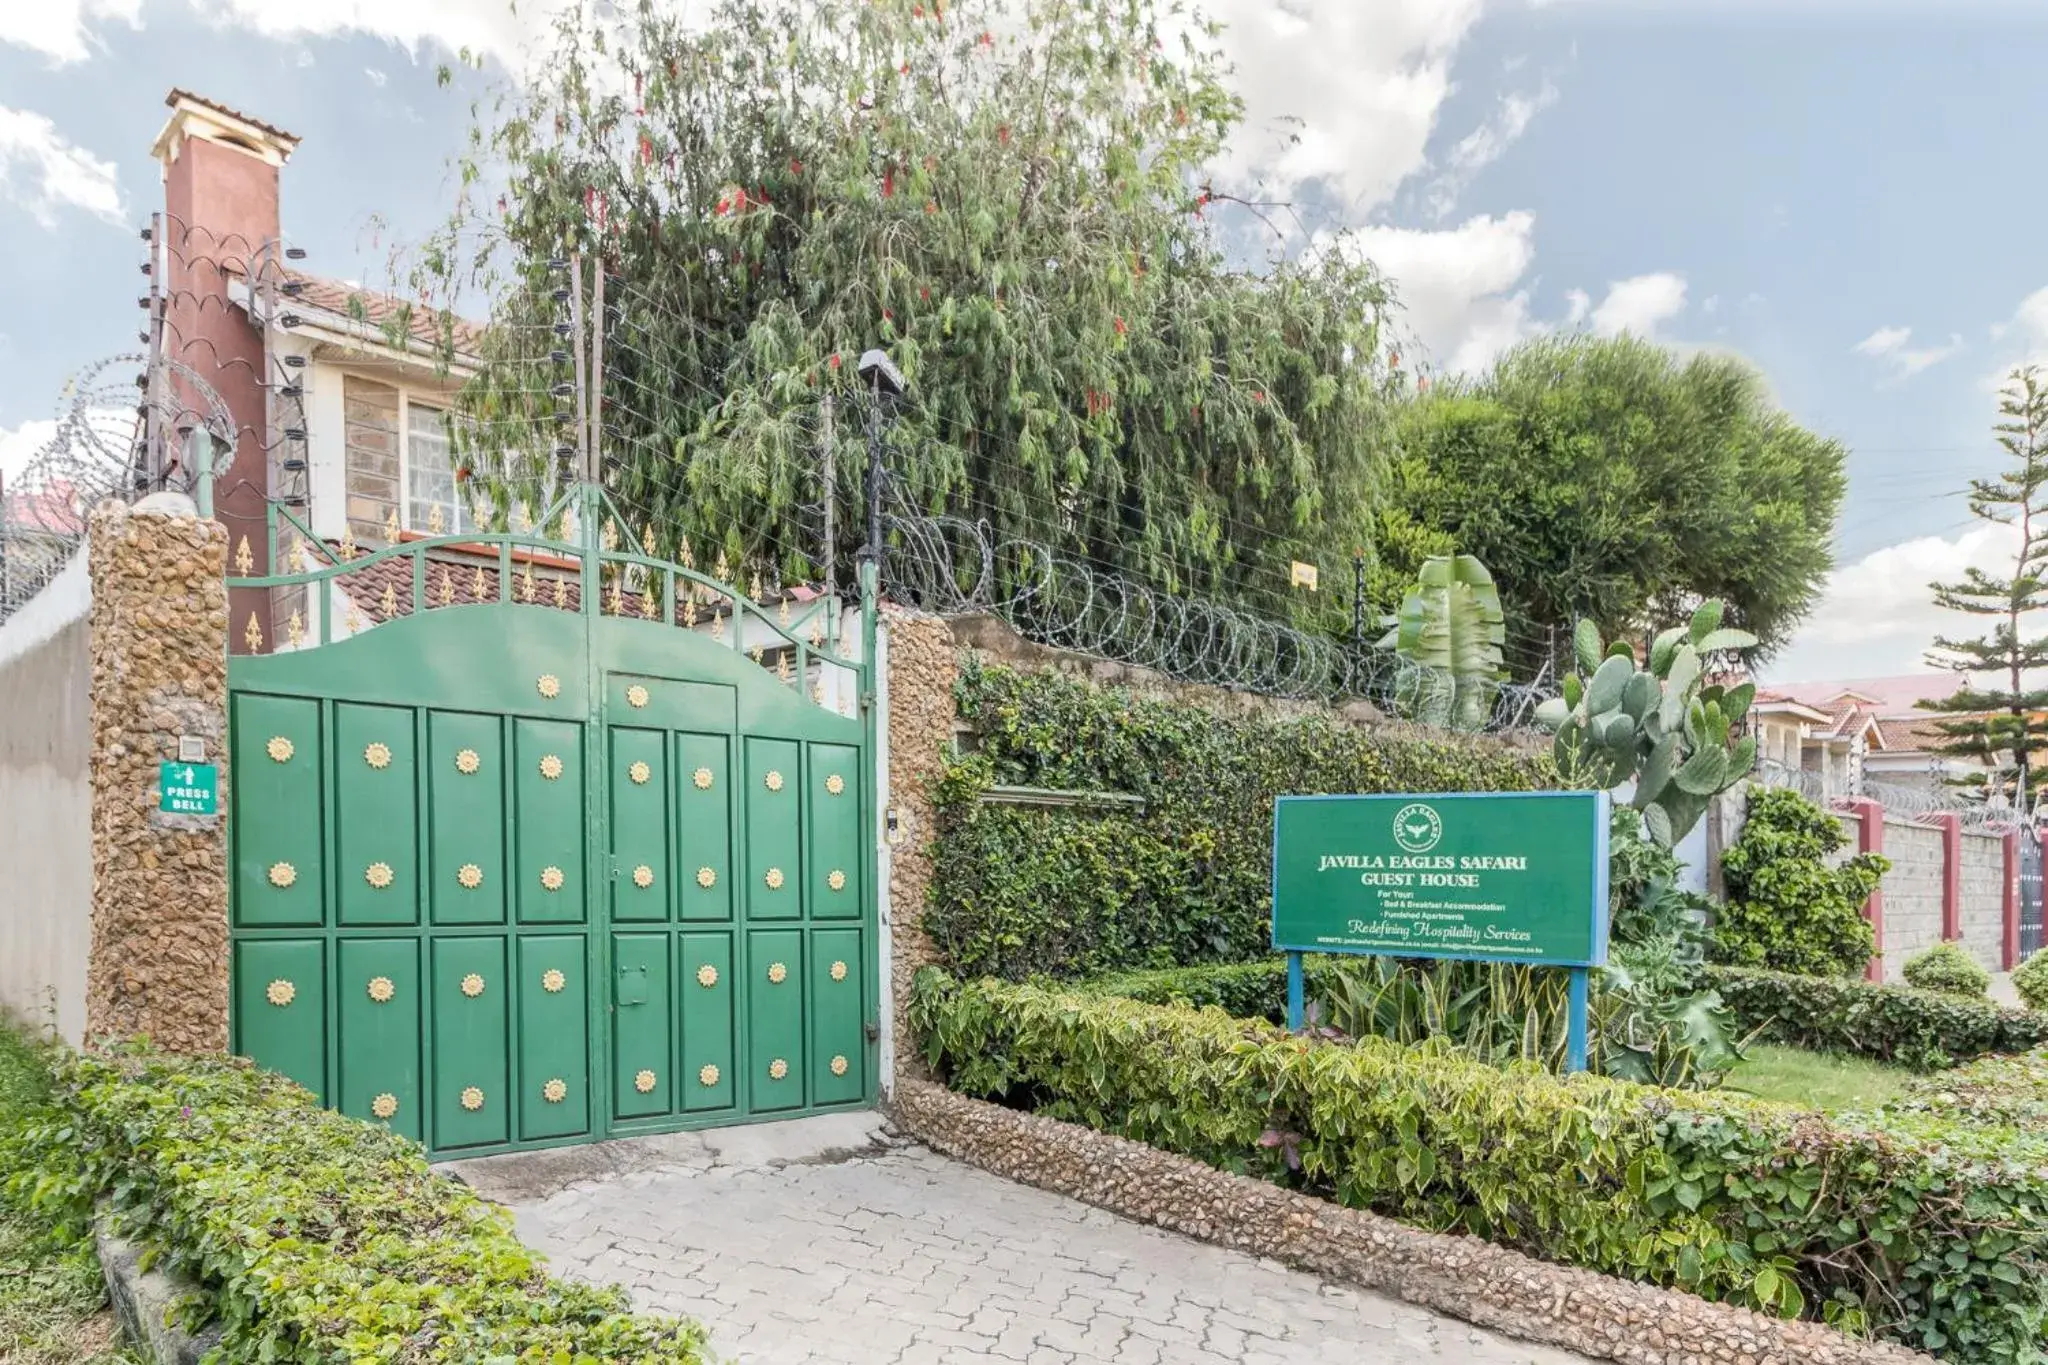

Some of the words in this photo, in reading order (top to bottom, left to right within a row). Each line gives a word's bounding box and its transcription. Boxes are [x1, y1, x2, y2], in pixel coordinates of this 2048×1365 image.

[167, 787, 209, 799] PRESS
[172, 800, 204, 810] BELL
[1319, 855, 1384, 871] JAVILLA
[1389, 856, 1454, 869] EAGLES
[1460, 856, 1526, 870] SAFARI
[1361, 873, 1415, 886] GUEST
[1420, 874, 1480, 887] HOUSE
[1377, 890, 1392, 898] For
[1384, 900, 1398, 908] Bed
[1407, 900, 1442, 909] Breakfast
[1384, 910, 1421, 919] Furnished
[1422, 912, 1464, 921] Apartments
[1347, 919, 1410, 940] Redefining
[1413, 921, 1480, 943] Hospitality
[1484, 924, 1531, 941] Services
